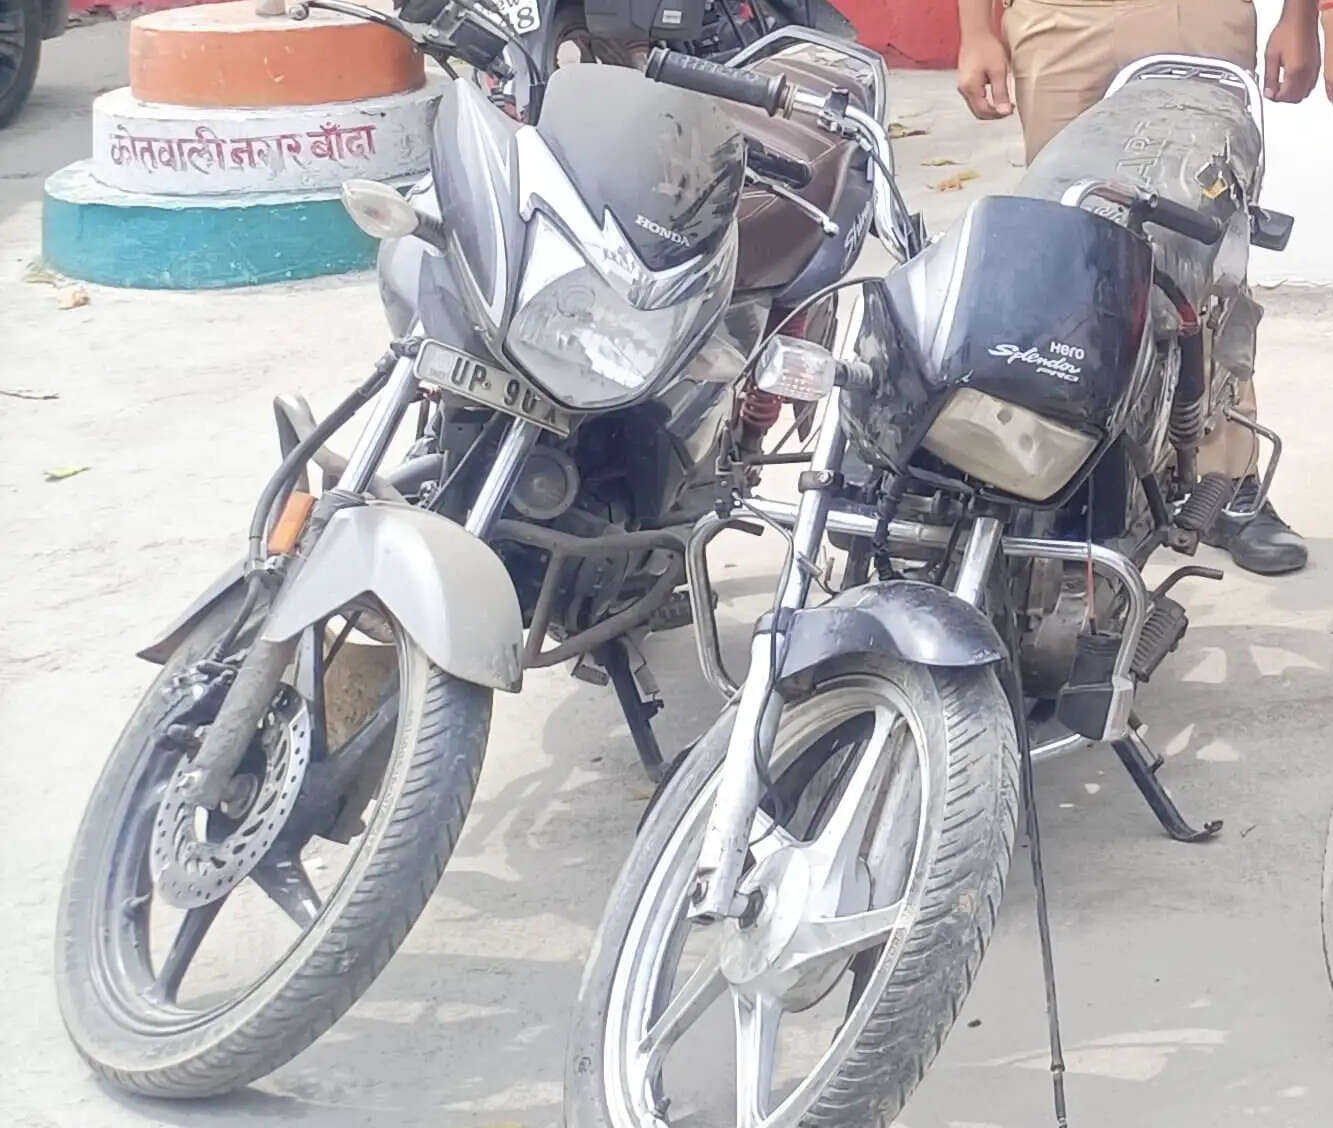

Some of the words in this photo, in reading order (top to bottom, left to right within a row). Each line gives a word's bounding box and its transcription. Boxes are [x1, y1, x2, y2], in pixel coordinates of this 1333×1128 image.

[635, 214, 690, 248] HONDA
[987, 344, 1082, 374] Splendor
[1050, 341, 1085, 360] Hero
